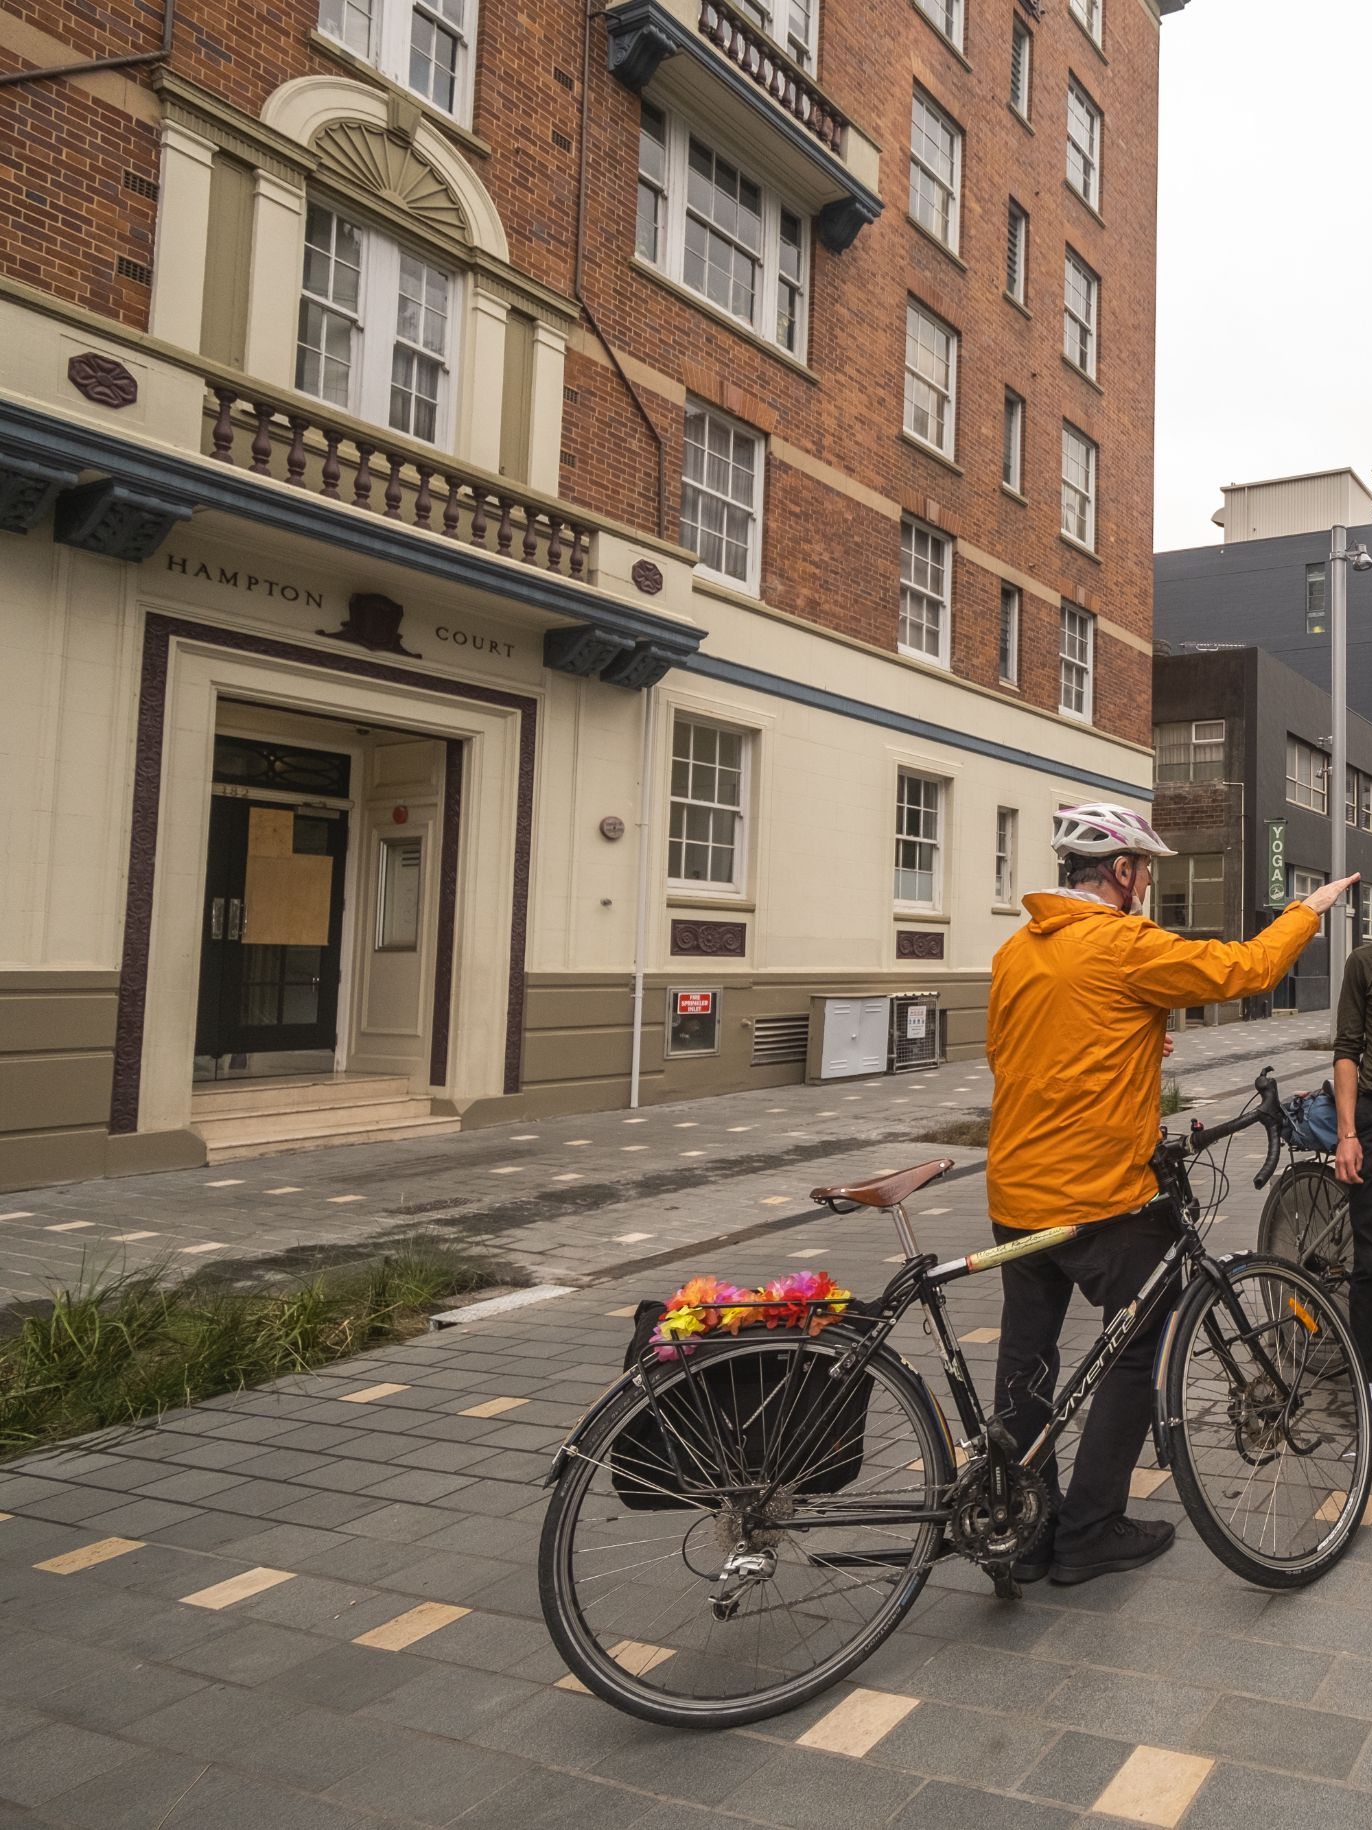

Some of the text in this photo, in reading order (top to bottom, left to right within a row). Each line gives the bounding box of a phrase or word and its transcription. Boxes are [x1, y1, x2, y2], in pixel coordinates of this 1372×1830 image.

[166, 554, 515, 658] HAMPTON COURT
[1271, 826, 1284, 881] YOGA
